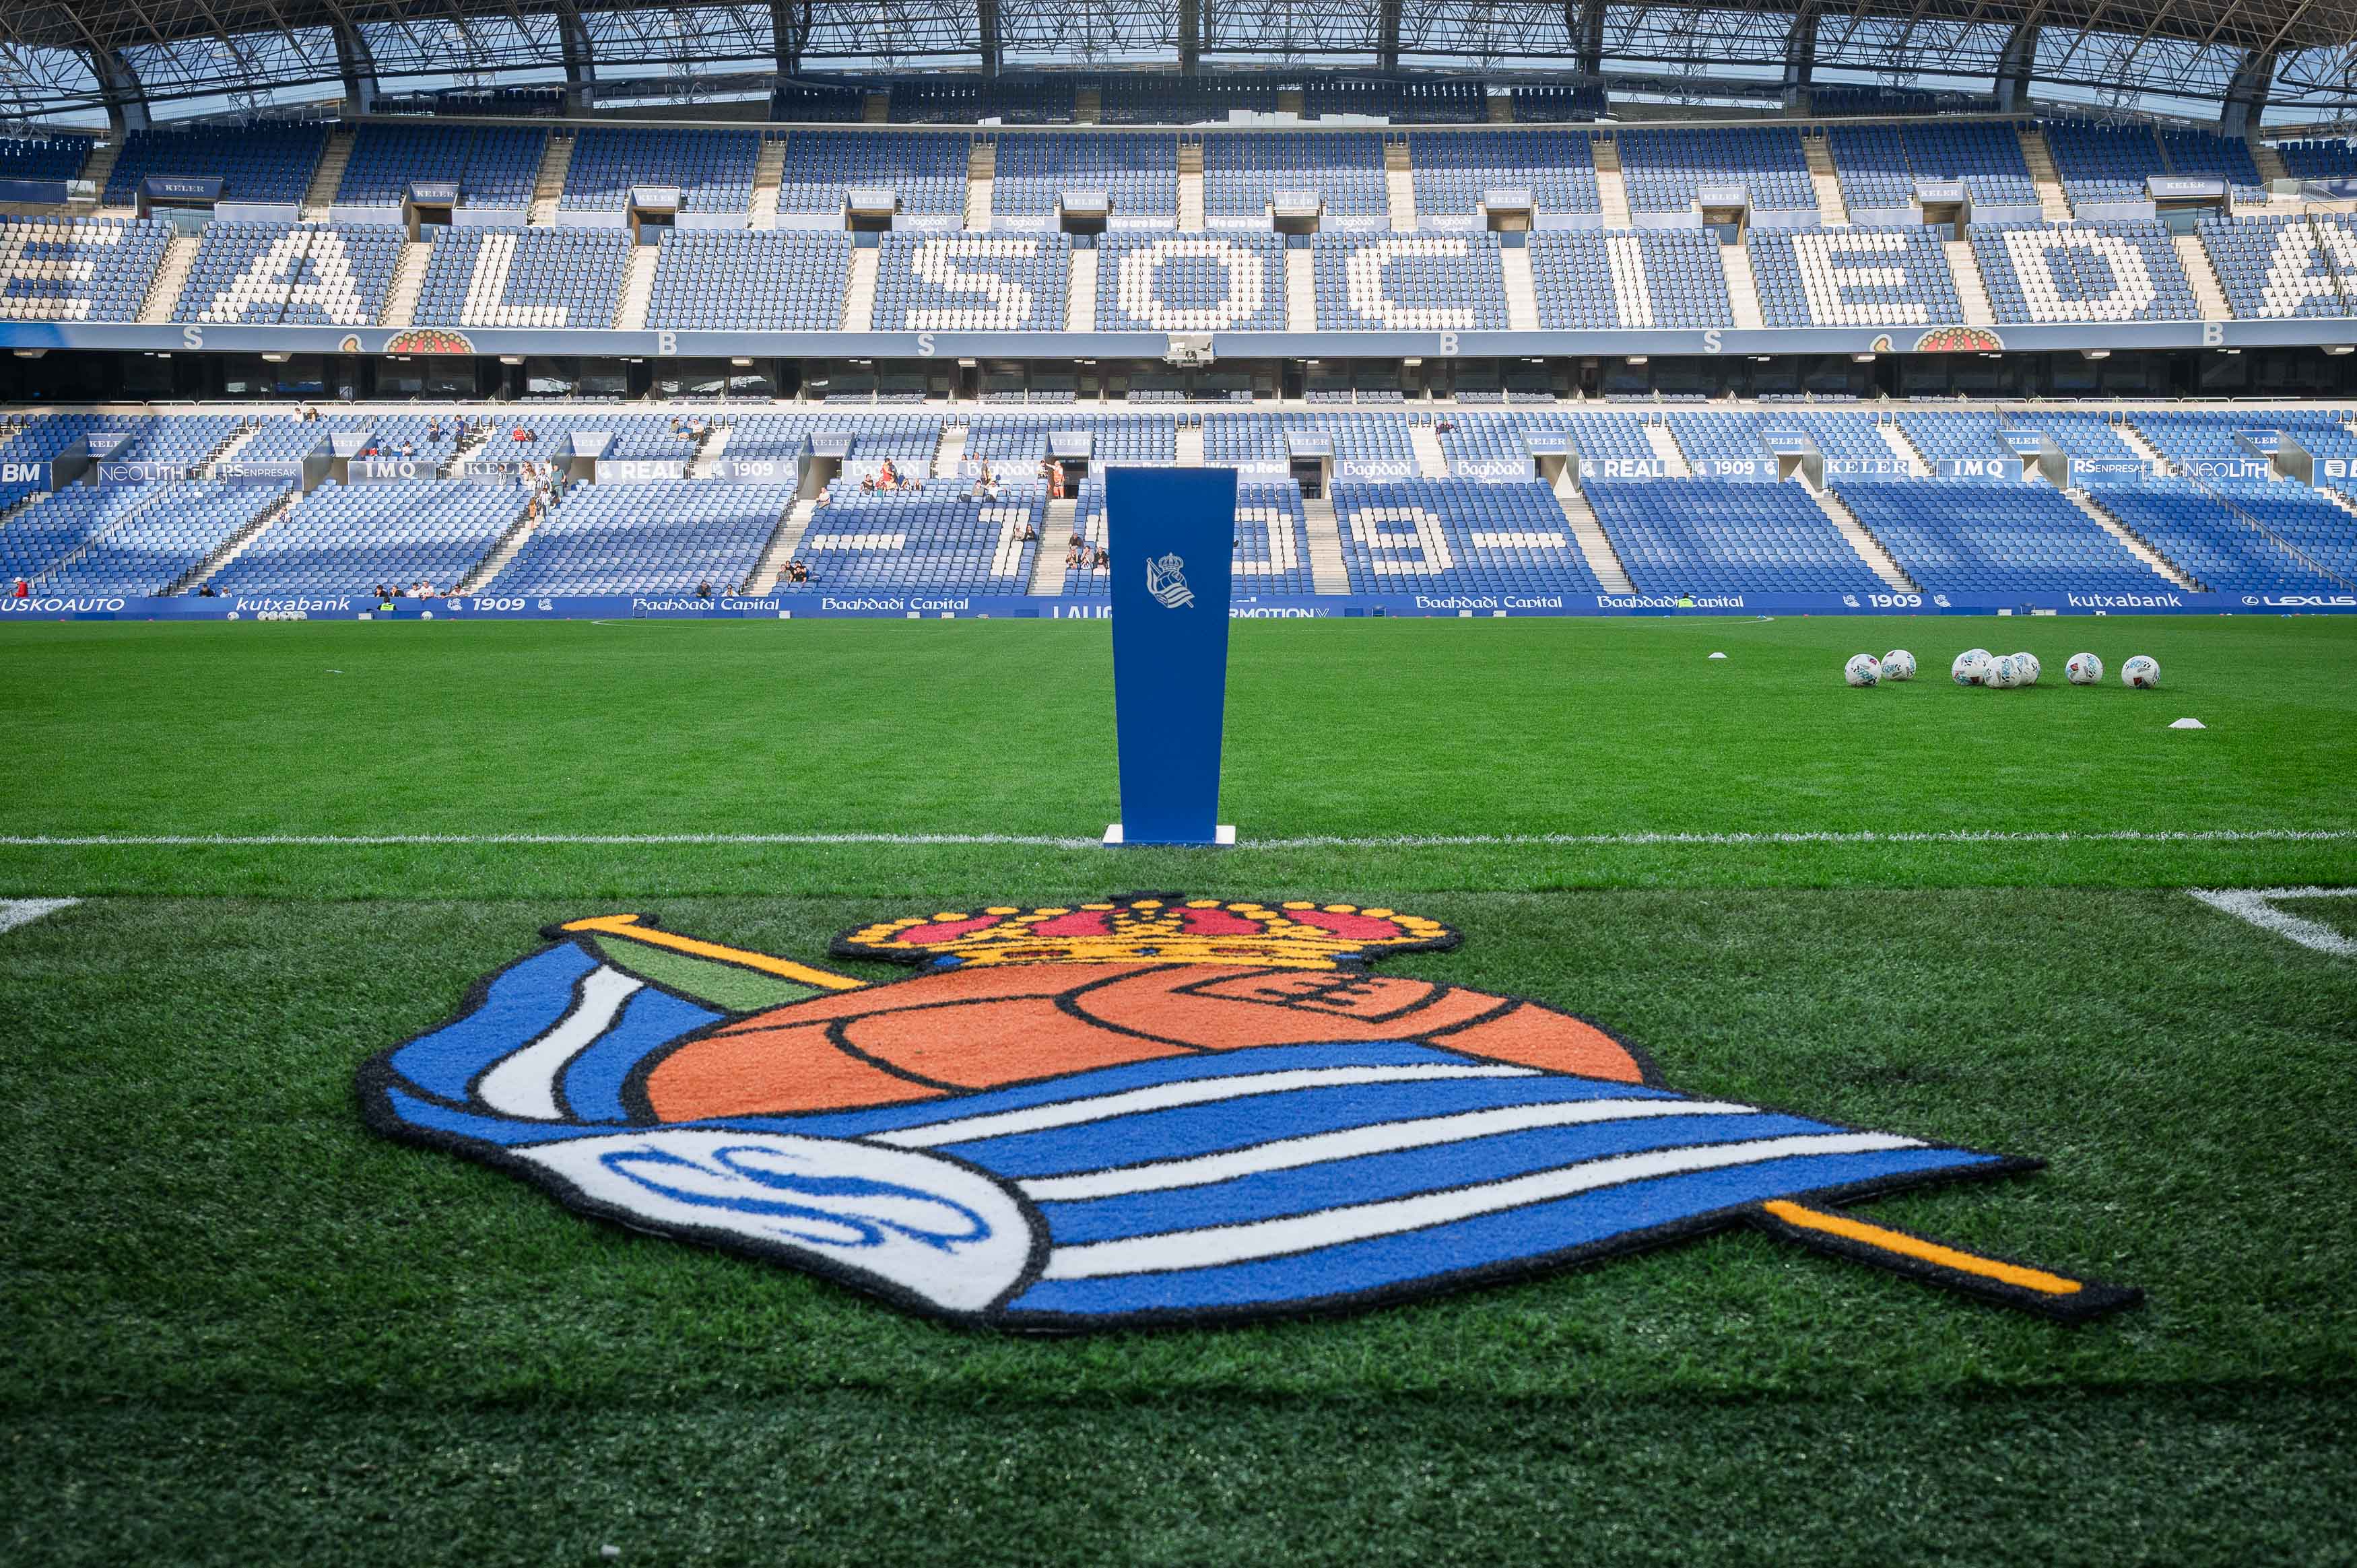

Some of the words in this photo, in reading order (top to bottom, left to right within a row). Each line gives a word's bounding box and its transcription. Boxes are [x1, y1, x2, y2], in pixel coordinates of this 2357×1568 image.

[164, 184, 205, 193] KELER
[636, 194, 675, 202] KELER
[183, 326, 203, 349] S
[1703, 330, 1722, 353] S
[2203, 322, 2224, 346] B
[659, 332, 677, 355] B
[917, 333, 936, 357] S
[1439, 333, 1459, 356] B
[2, 464, 40, 482] BM
[366, 463, 418, 480] IMQ
[621, 462, 683, 479] REAL
[732, 462, 774, 476] 1909
[1257, 462, 1288, 474] Real
[1343, 461, 1411, 478] Baghdadi
[1458, 461, 1525, 477] Baghdadi
[1604, 460, 1665, 478] REAL
[1714, 461, 1755, 475] 1909
[1826, 461, 1908, 474] KELER
[1954, 461, 2005, 479] IMQ
[236, 596, 351, 611] kutxabank
[473, 597, 526, 611] 1909
[632, 597, 715, 611] Baghdadi
[721, 597, 780, 611] Capital
[822, 597, 904, 611] Baghdadi
[911, 597, 969, 611] Capital
[1416, 595, 1498, 609] Baghdadi
[1504, 595, 1562, 609] Capital
[1597, 595, 1678, 609] Baghdadi
[1868, 594, 1922, 607] 1909
[2067, 592, 2183, 607] kutxabank
[2263, 595, 2357, 607] LEXUS
